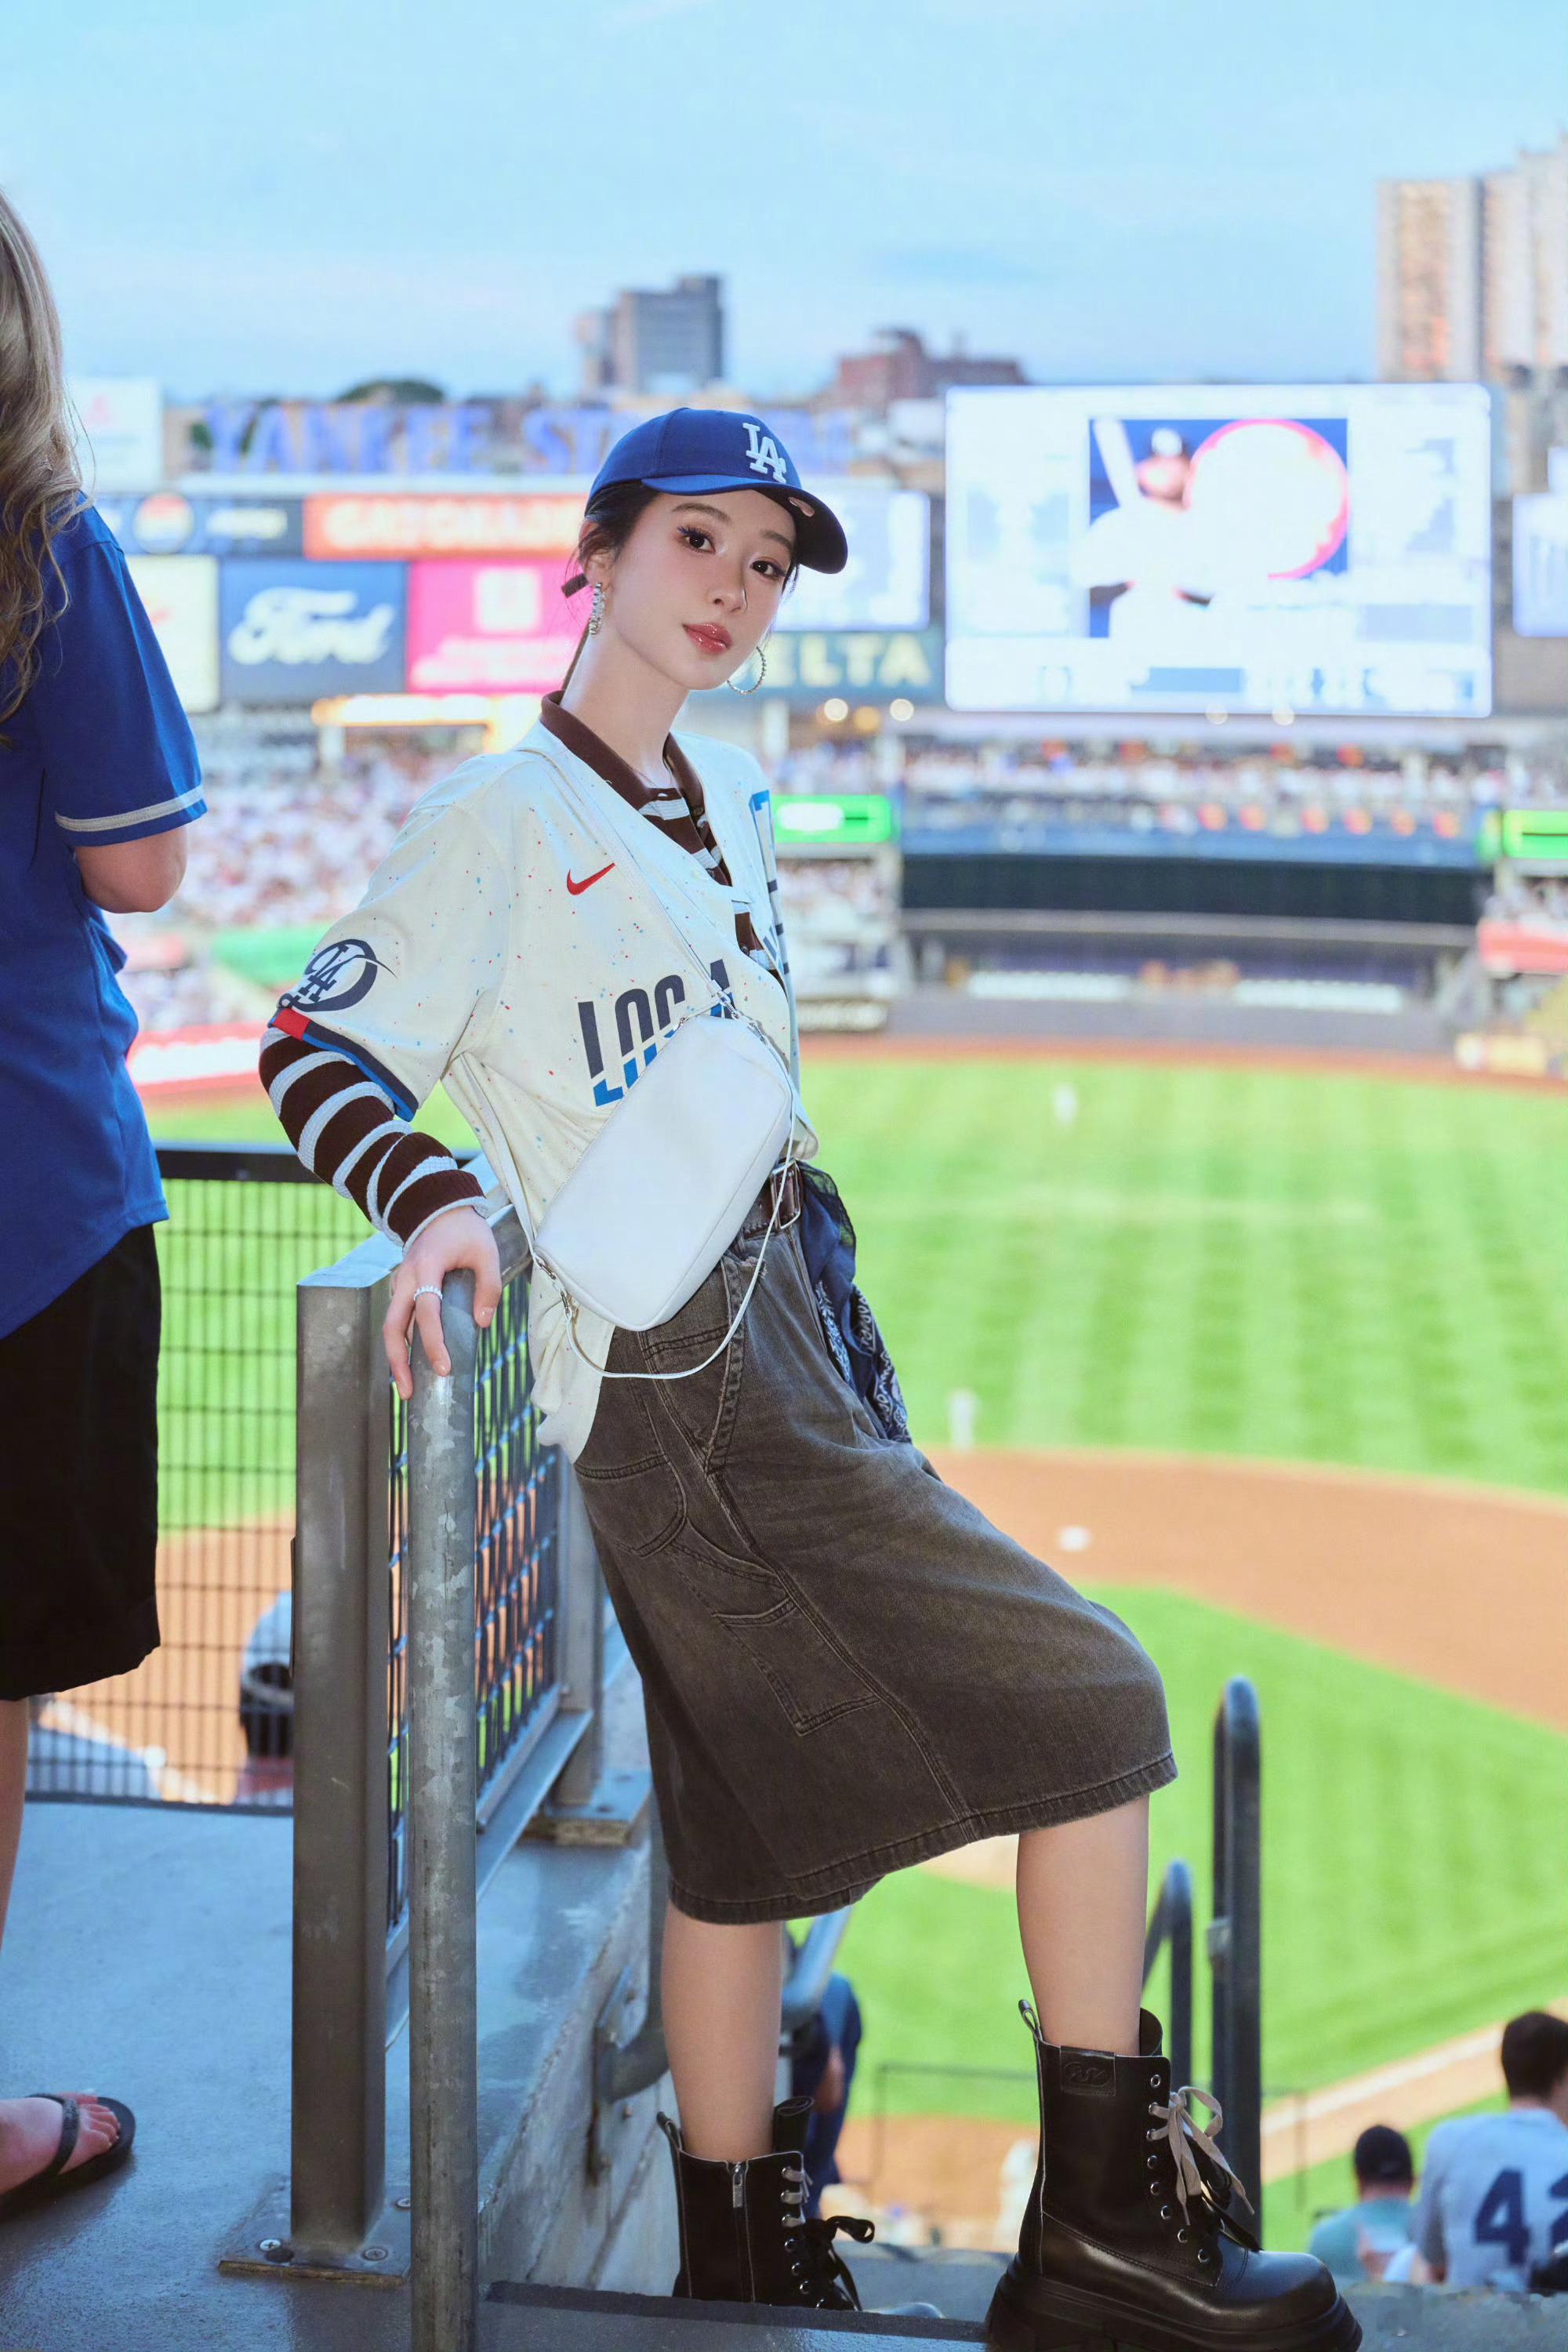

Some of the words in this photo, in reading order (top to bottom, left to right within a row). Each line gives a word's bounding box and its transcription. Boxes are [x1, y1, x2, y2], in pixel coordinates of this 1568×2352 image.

[742, 422, 787, 485] LA
[227, 586, 395, 666] Ford
[757, 632, 932, 688] ELTA
